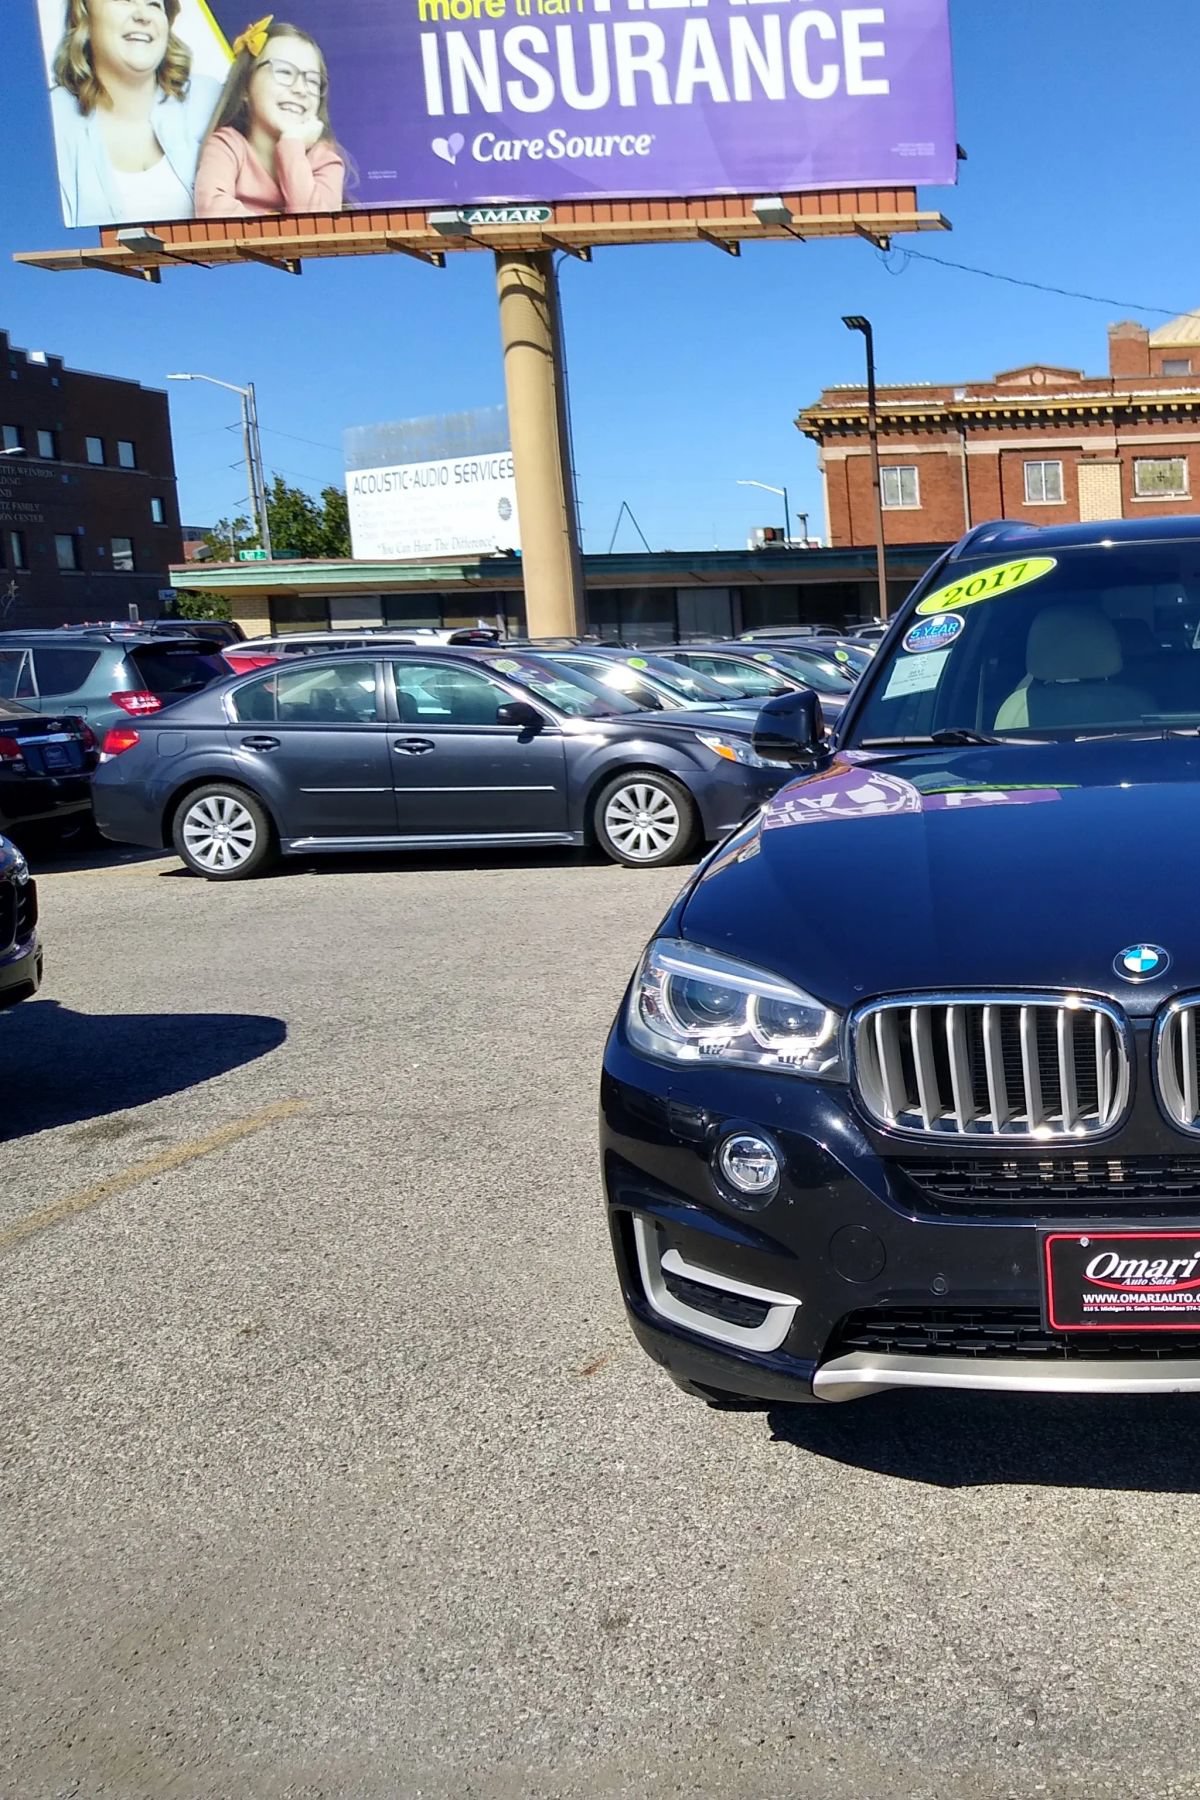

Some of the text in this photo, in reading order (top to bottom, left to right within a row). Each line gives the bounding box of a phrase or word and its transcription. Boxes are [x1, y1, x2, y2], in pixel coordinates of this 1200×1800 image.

[418, 0, 506, 21] more
[420, 7, 891, 117] INSURANCE
[471, 128, 651, 163] CareSource
[459, 208, 541, 223] AMAR
[454, 458, 515, 484] SERVICES
[434, 537, 449, 551] The
[941, 562, 1029, 608] 2017
[910, 622, 959, 639] 5 YEAR
[1121, 1277, 1177, 1286] Auto Sales
[1100, 1305, 1125, 1313] Michigan
